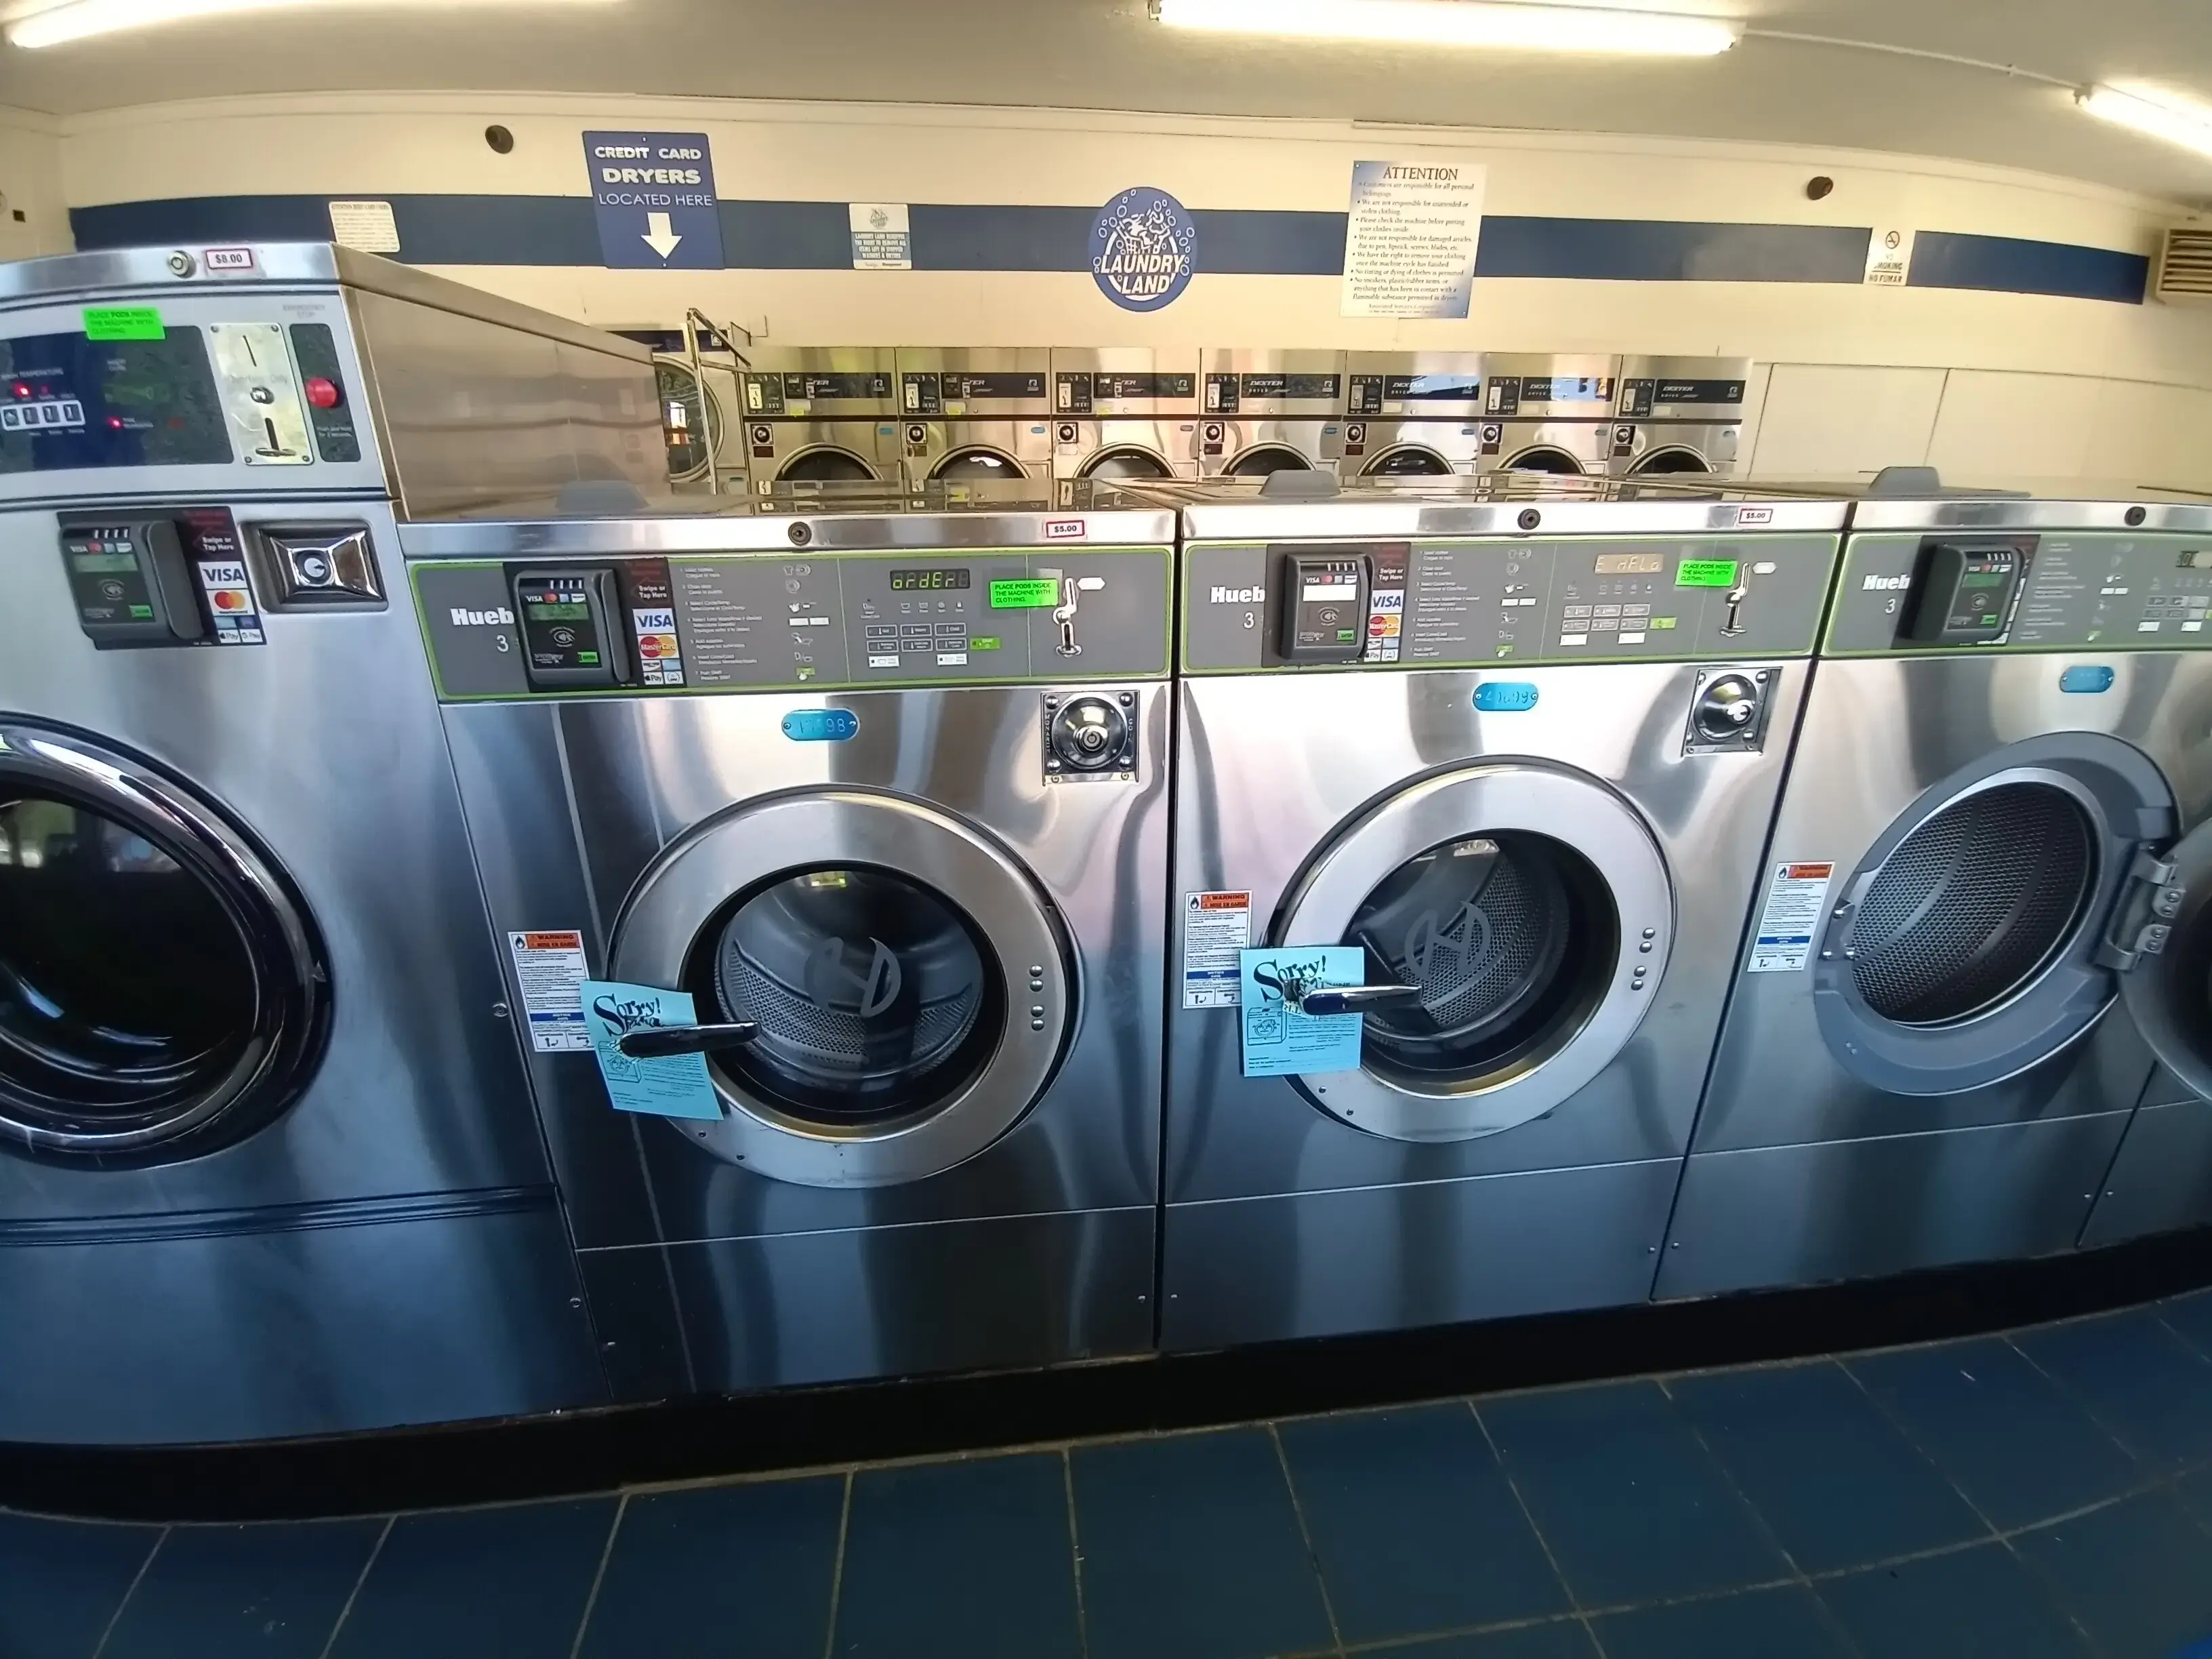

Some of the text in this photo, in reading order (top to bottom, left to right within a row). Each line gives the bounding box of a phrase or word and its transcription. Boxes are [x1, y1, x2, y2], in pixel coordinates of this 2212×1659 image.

[594, 146, 702, 160] CREDIT CARD
[602, 167, 701, 184] DRYERS
[1383, 167, 1458, 180] ATTENTION
[598, 193, 712, 206] LOCATED HERE
[216, 254, 243, 264] $8.00
[1390, 252, 1403, 260] right
[1101, 254, 1186, 274] LAUNDRY
[1122, 274, 1170, 294] LAND
[1879, 274, 1902, 283] FUMAR
[203, 569, 245, 582] VISA
[1862, 575, 1911, 590] Hueb
[1211, 586, 1265, 603] Hueb
[1373, 596, 1401, 607] VISA
[450, 607, 515, 626] Hueb
[636, 615, 673, 628] VISA
[1254, 955, 1326, 1003] Sorry!
[593, 994, 661, 1037] Sorry!
